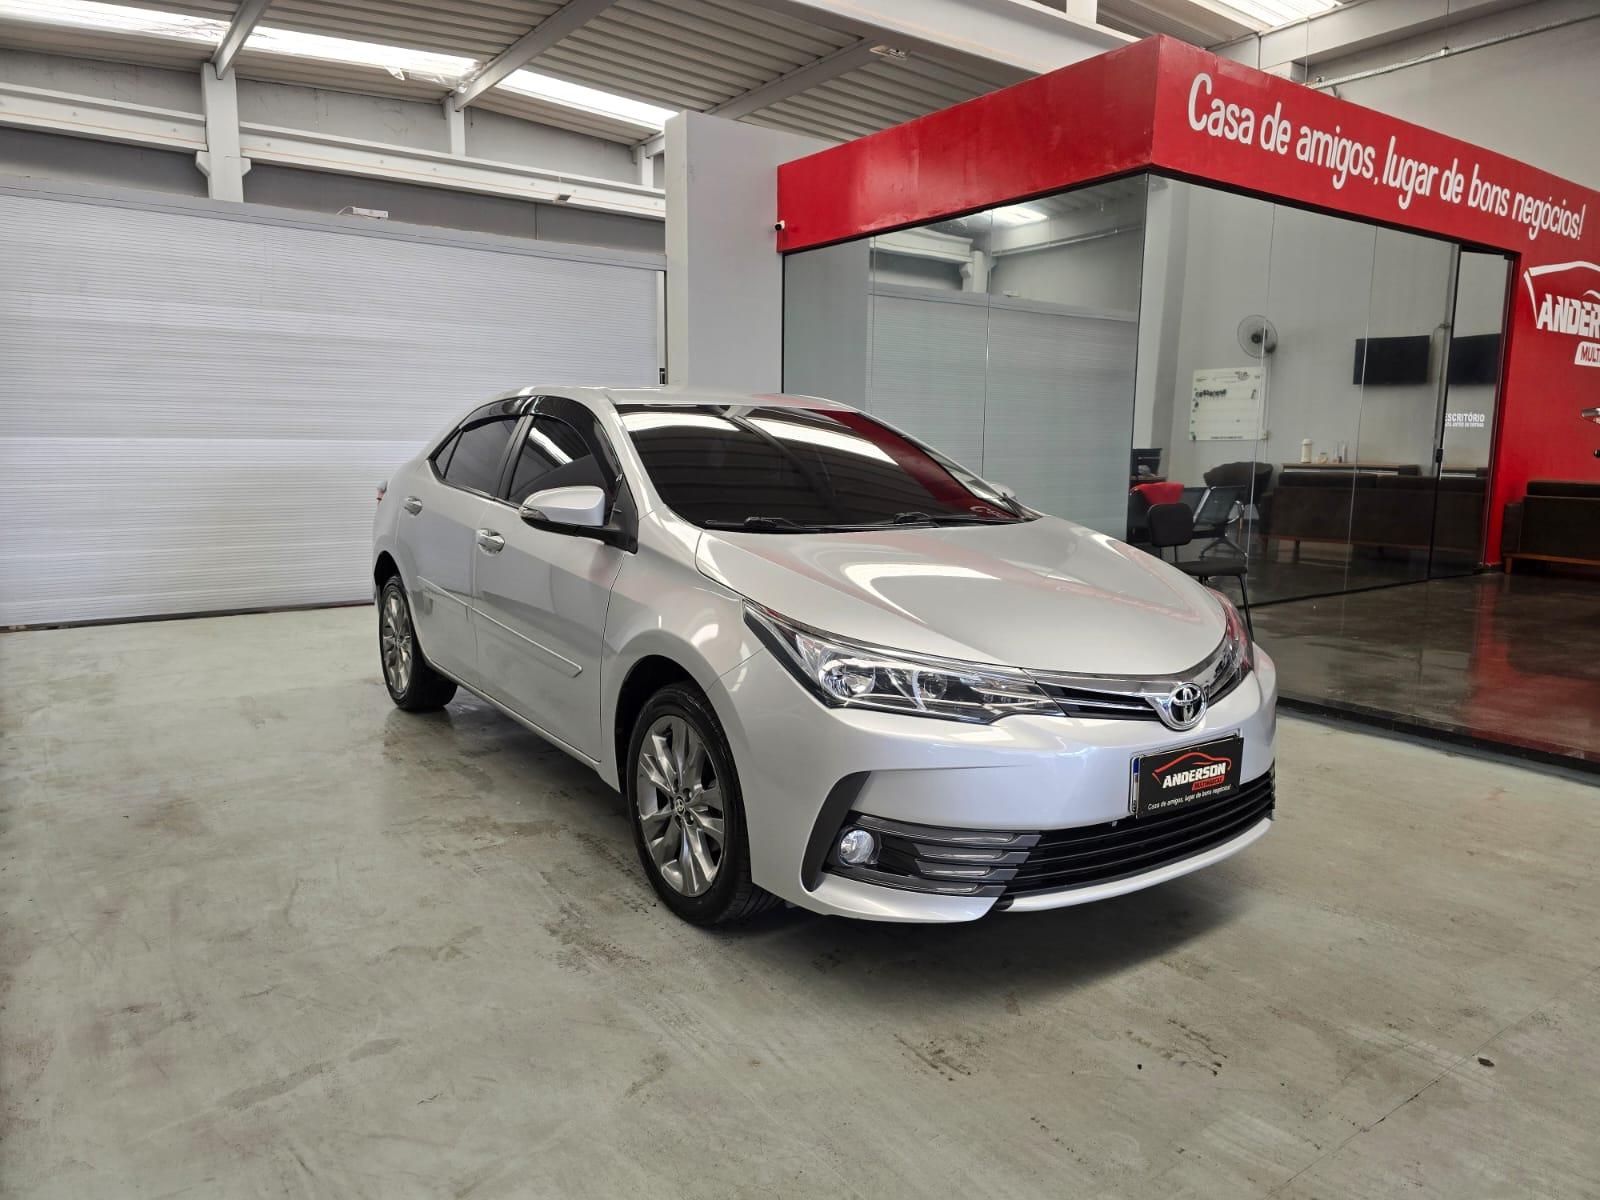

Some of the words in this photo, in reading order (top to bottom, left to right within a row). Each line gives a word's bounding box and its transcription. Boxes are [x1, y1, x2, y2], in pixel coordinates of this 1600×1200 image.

[1188, 73, 1255, 144] Casa
[1260, 101, 1291, 155] de
[1296, 125, 1379, 190] amigos,
[1382, 135, 1439, 210] lugar
[1440, 157, 1464, 204] de
[1468, 163, 1510, 217] bons
[1512, 191, 1586, 240] negócios!
[1162, 762, 1226, 788] ANDERSON
